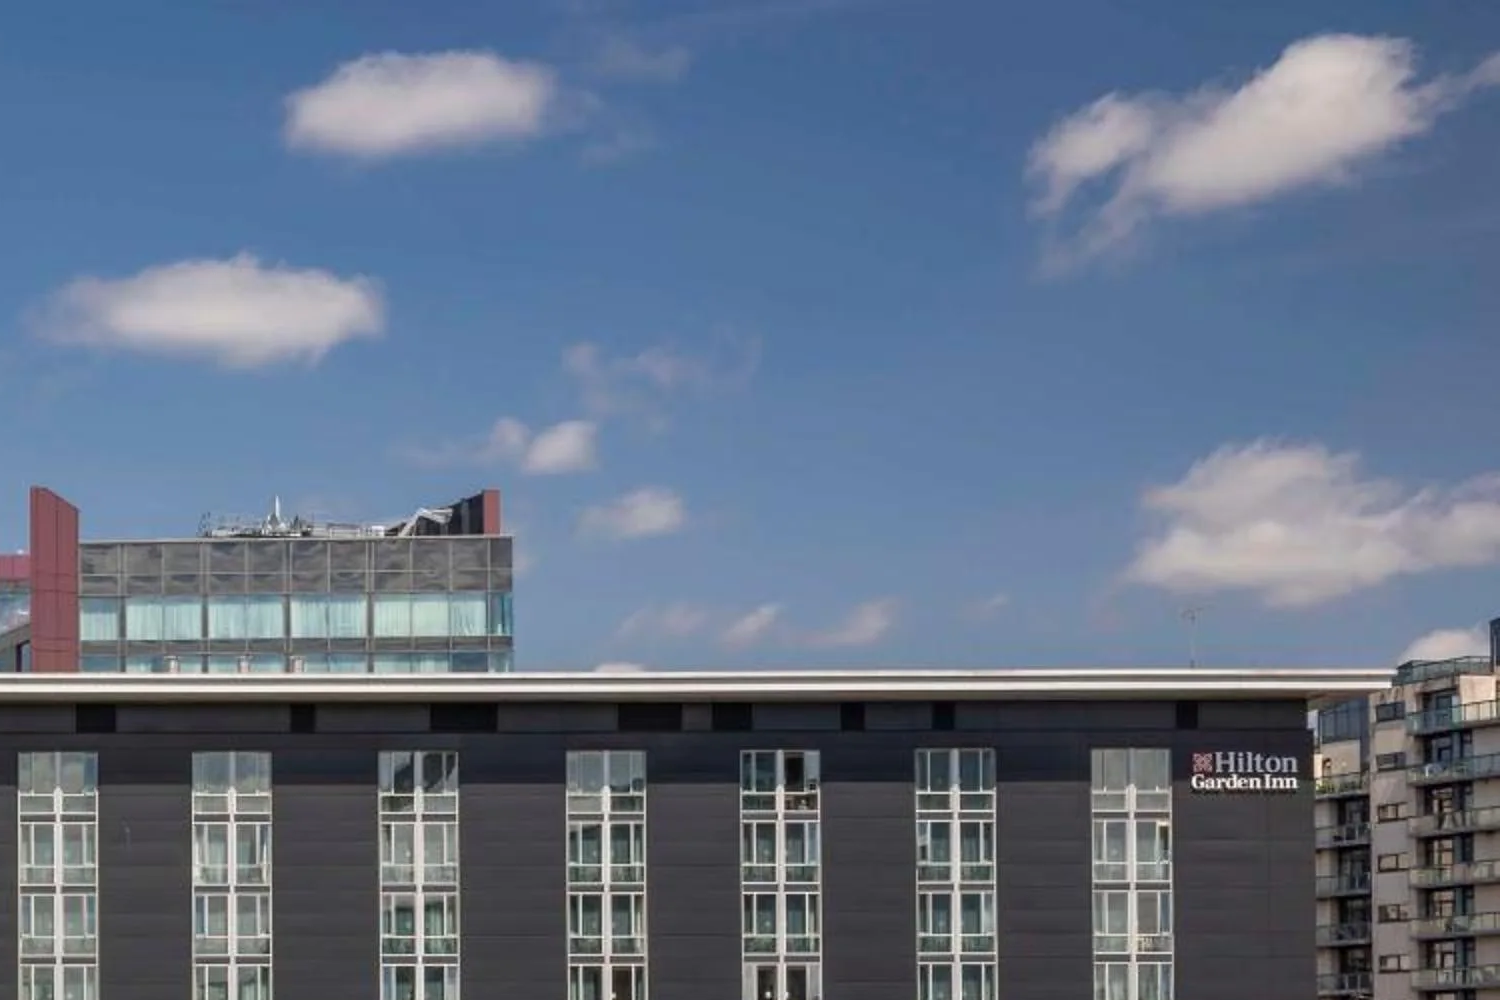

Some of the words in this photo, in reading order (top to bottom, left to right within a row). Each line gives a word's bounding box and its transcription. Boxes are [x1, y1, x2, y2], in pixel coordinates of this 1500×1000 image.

[1215, 751, 1298, 773] Hilton
[1191, 774, 1261, 789] Garden
[1264, 774, 1298, 789] Inn
